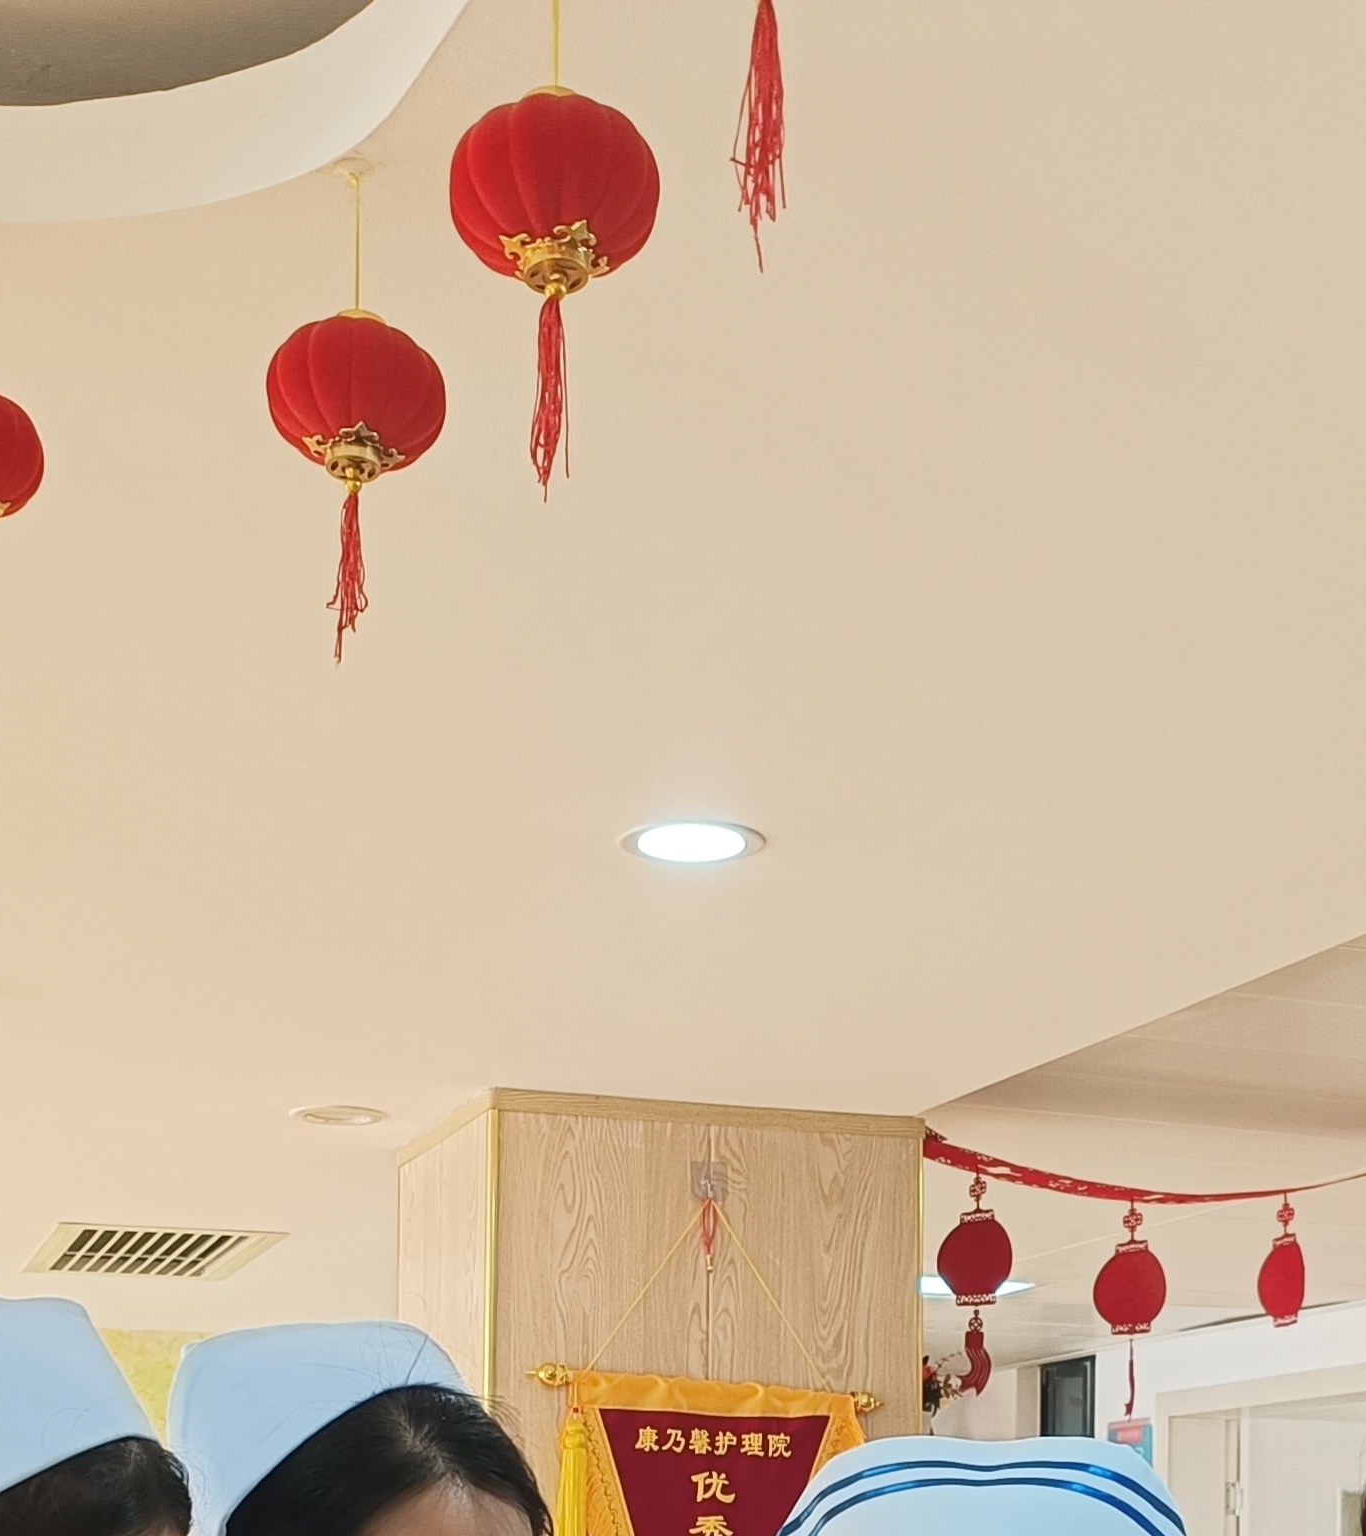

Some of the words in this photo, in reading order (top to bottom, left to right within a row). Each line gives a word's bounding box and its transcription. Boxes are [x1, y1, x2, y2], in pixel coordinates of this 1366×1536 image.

[634, 1426, 793, 1458] 康乃馨护理院
